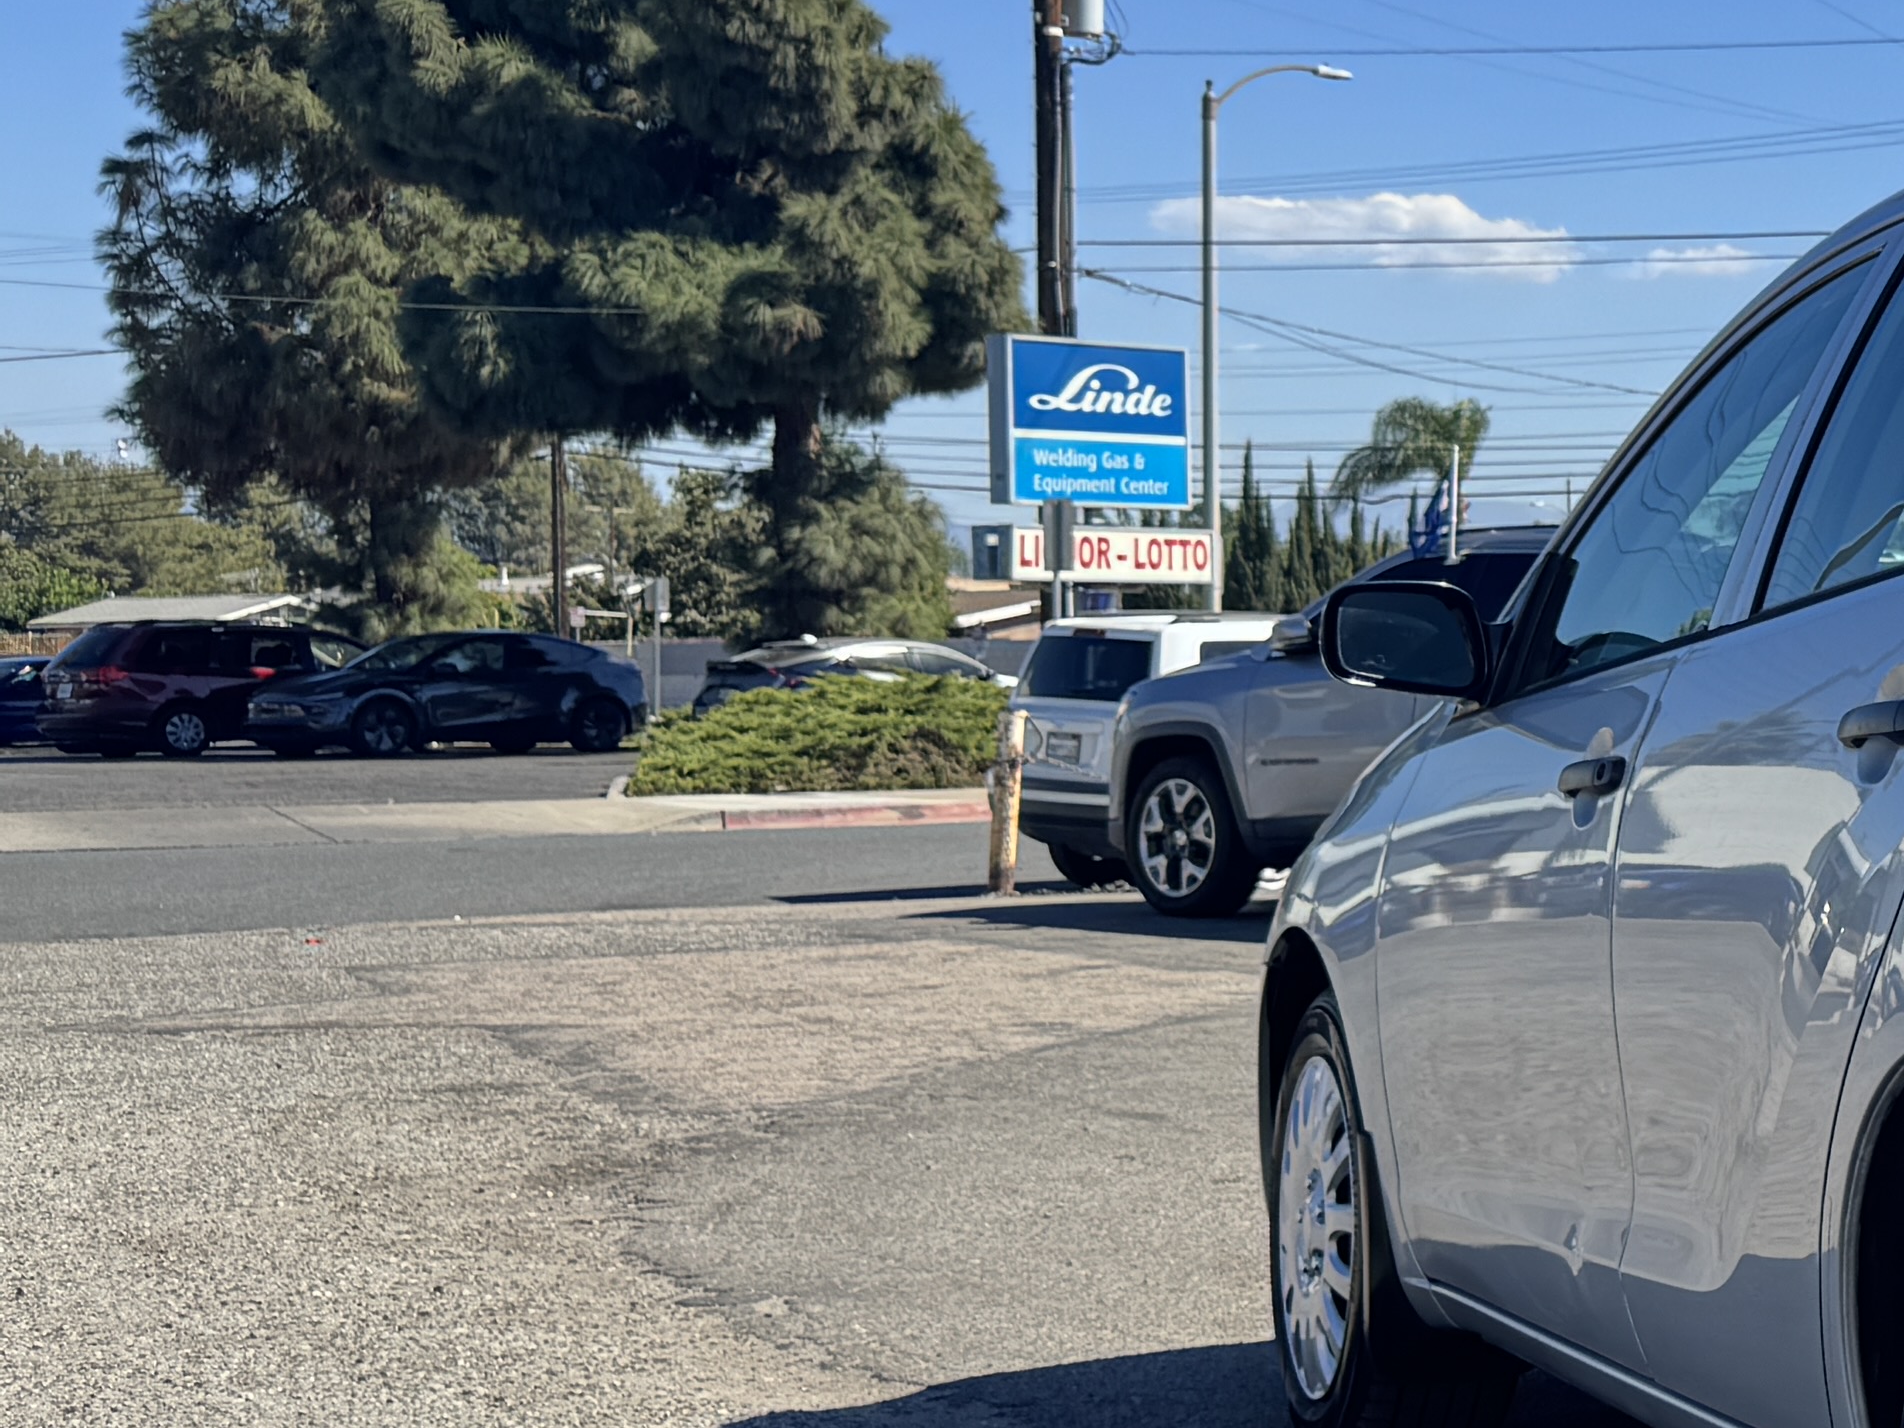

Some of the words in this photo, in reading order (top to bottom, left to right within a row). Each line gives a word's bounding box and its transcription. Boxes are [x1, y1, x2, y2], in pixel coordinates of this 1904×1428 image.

[1029, 363, 1172, 417] Linde
[1033, 448, 1097, 472] Welding
[1102, 451, 1129, 469] Gas
[1134, 453, 1145, 469] &
[1033, 474, 1116, 495] Equipment
[1120, 476, 1169, 495] Center
[1020, 534, 1111, 570] LIOR
[1134, 538, 1207, 571] LOTTO
